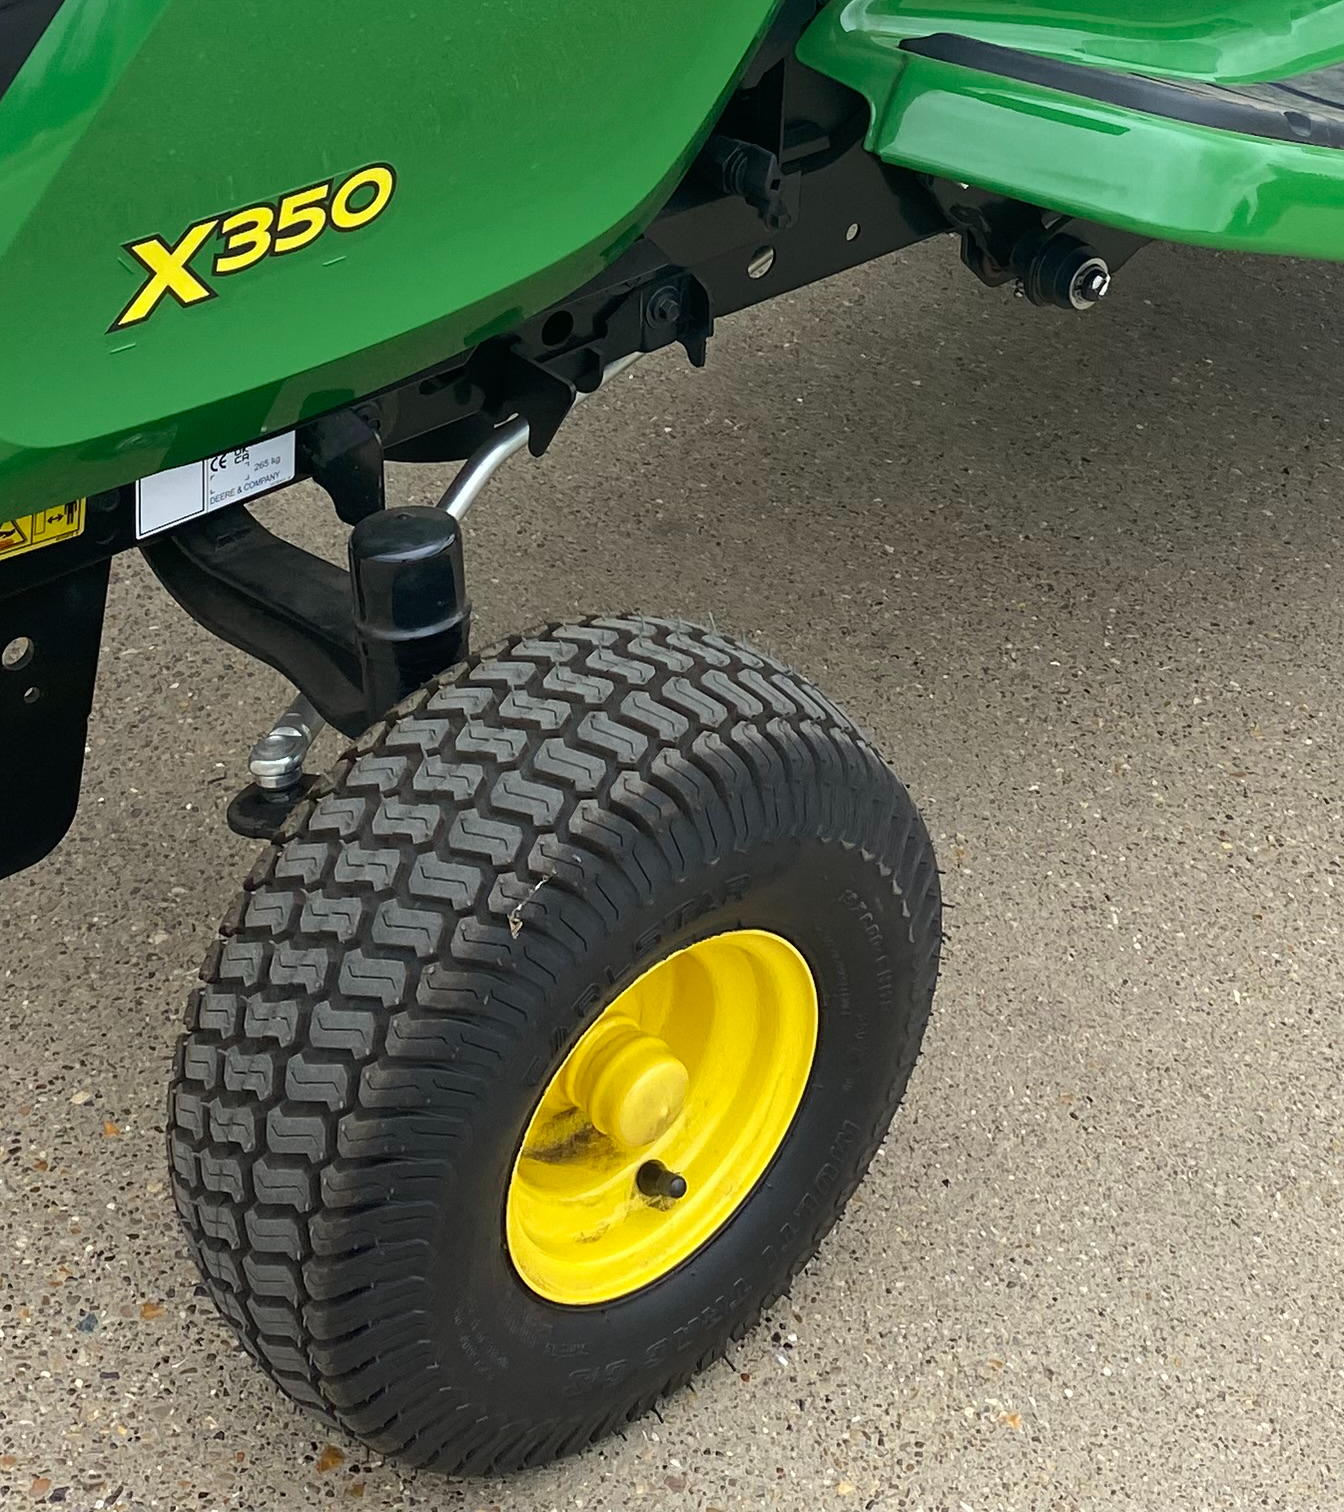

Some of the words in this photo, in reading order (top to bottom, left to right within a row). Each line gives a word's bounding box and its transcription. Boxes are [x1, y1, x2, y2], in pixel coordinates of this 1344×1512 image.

[107, 163, 396, 333] X350
[254, 460, 269, 472] 265
[271, 456, 281, 465] kg
[209, 488, 236, 505] DEERE
[236, 485, 243, 494] &
[243, 470, 281, 491] COMPANY
